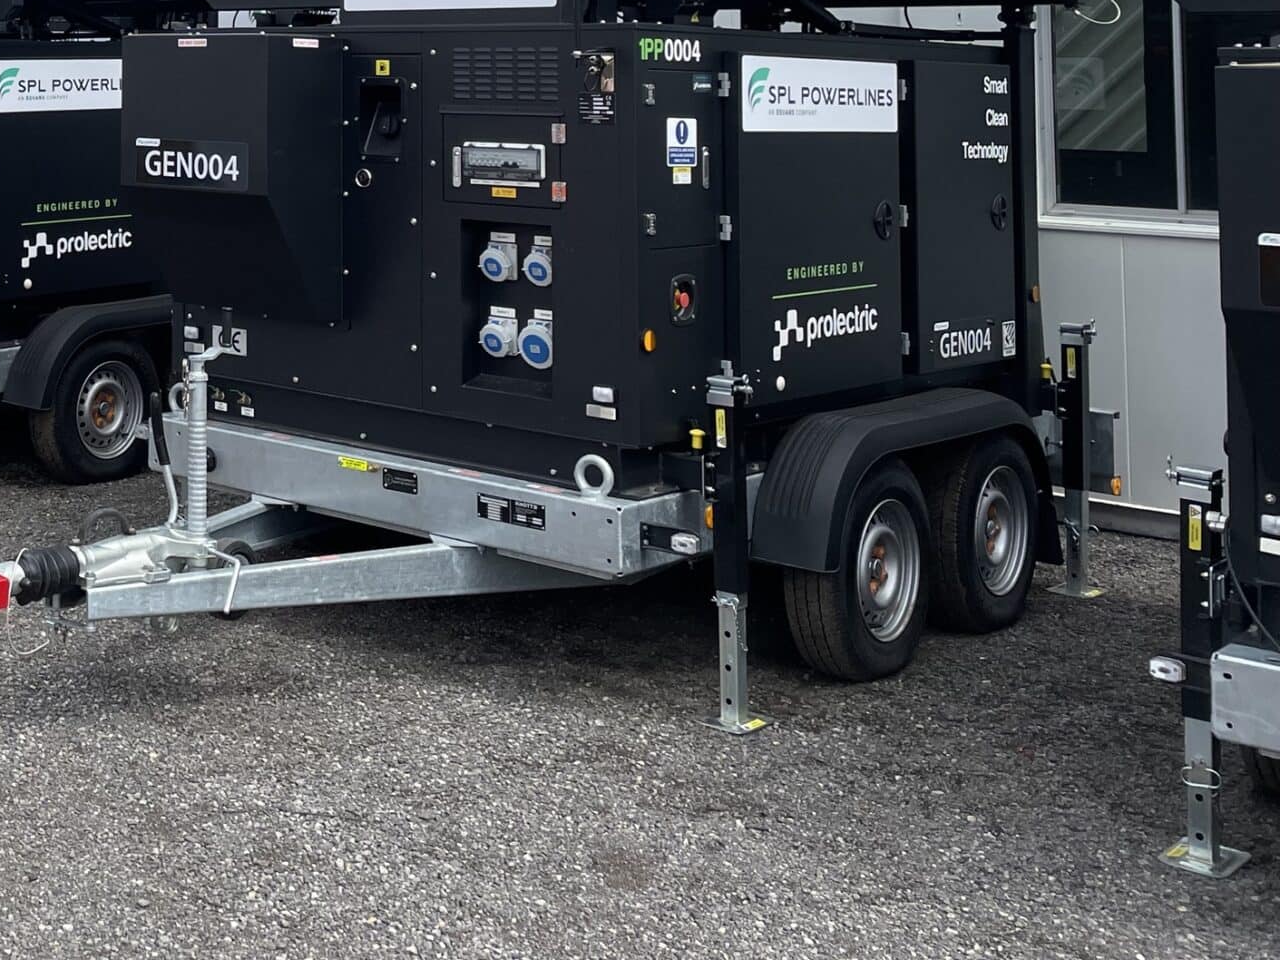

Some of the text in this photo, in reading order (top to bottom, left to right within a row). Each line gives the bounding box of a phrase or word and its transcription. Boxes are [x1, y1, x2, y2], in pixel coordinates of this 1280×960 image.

[639, 38, 701, 62] 1PP0004
[18, 78, 122, 93] SPL POWERLI
[983, 75, 1008, 94] Smart
[768, 86, 893, 107] SPL POWERLINES
[985, 108, 1009, 126] Clean
[962, 141, 1009, 164] Technology
[144, 149, 240, 181] GEN004
[36, 198, 118, 213] ENGINEERED BY
[56, 228, 133, 260] prolectric
[786, 261, 864, 280] ENGINEERED BY
[806, 303, 878, 348] prolectric
[940, 327, 992, 359] GEN004
